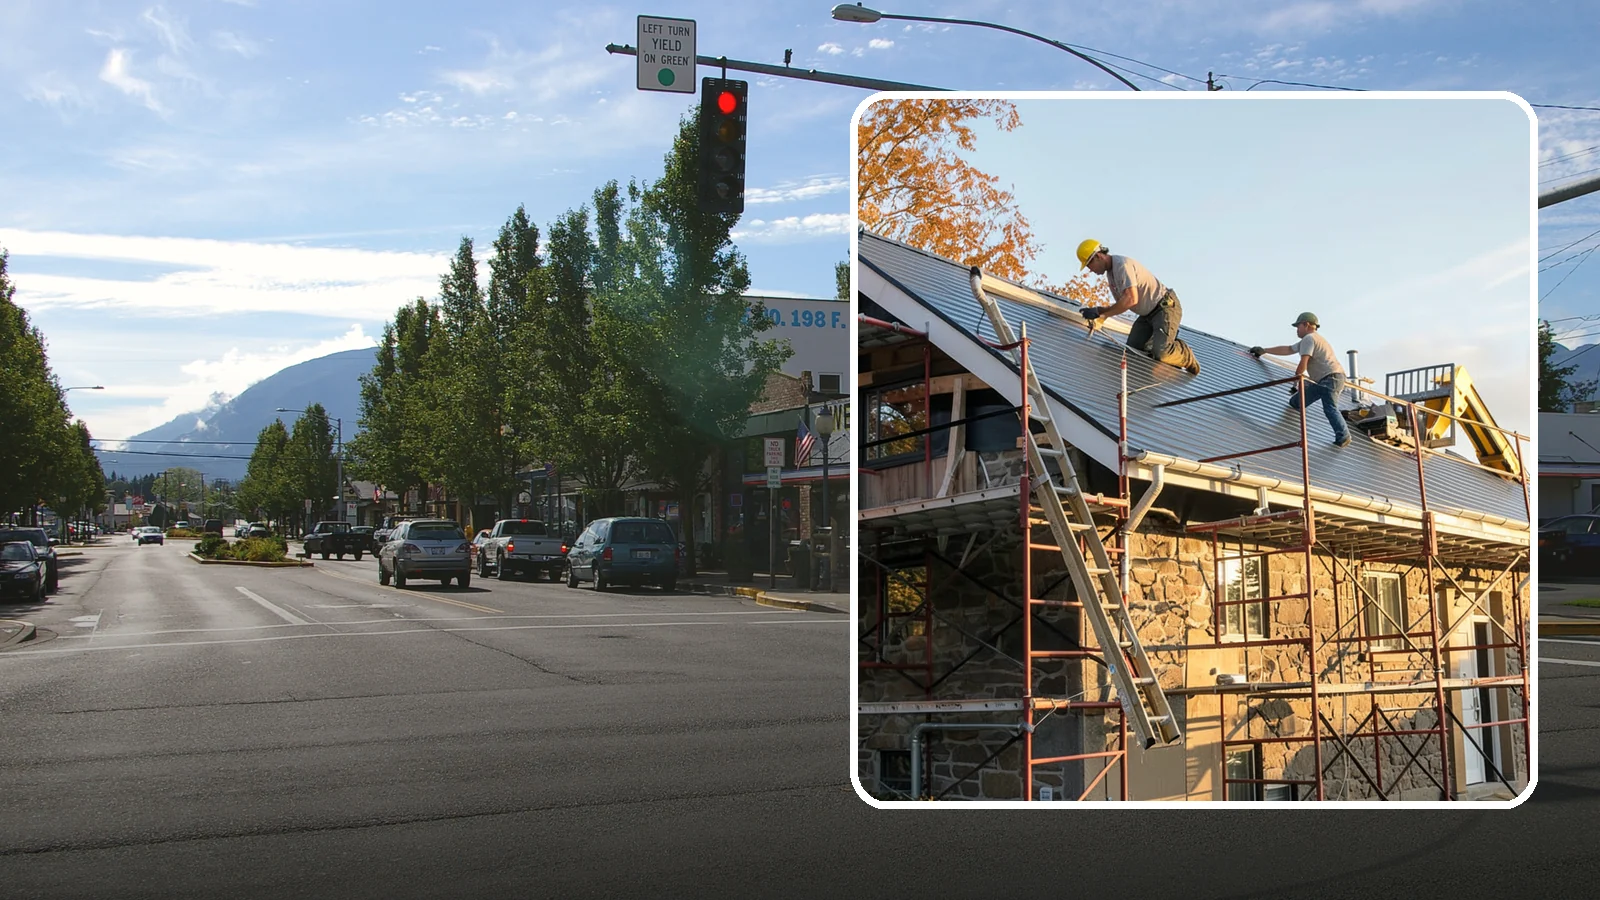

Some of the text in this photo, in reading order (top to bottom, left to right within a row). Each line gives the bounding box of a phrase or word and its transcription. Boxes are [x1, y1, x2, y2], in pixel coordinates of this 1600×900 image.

[643, 23, 690, 36] LEFT TURN
[652, 38, 682, 51] YIELD
[644, 53, 688, 66] ON GREEN
[791, 309, 826, 328] 198
